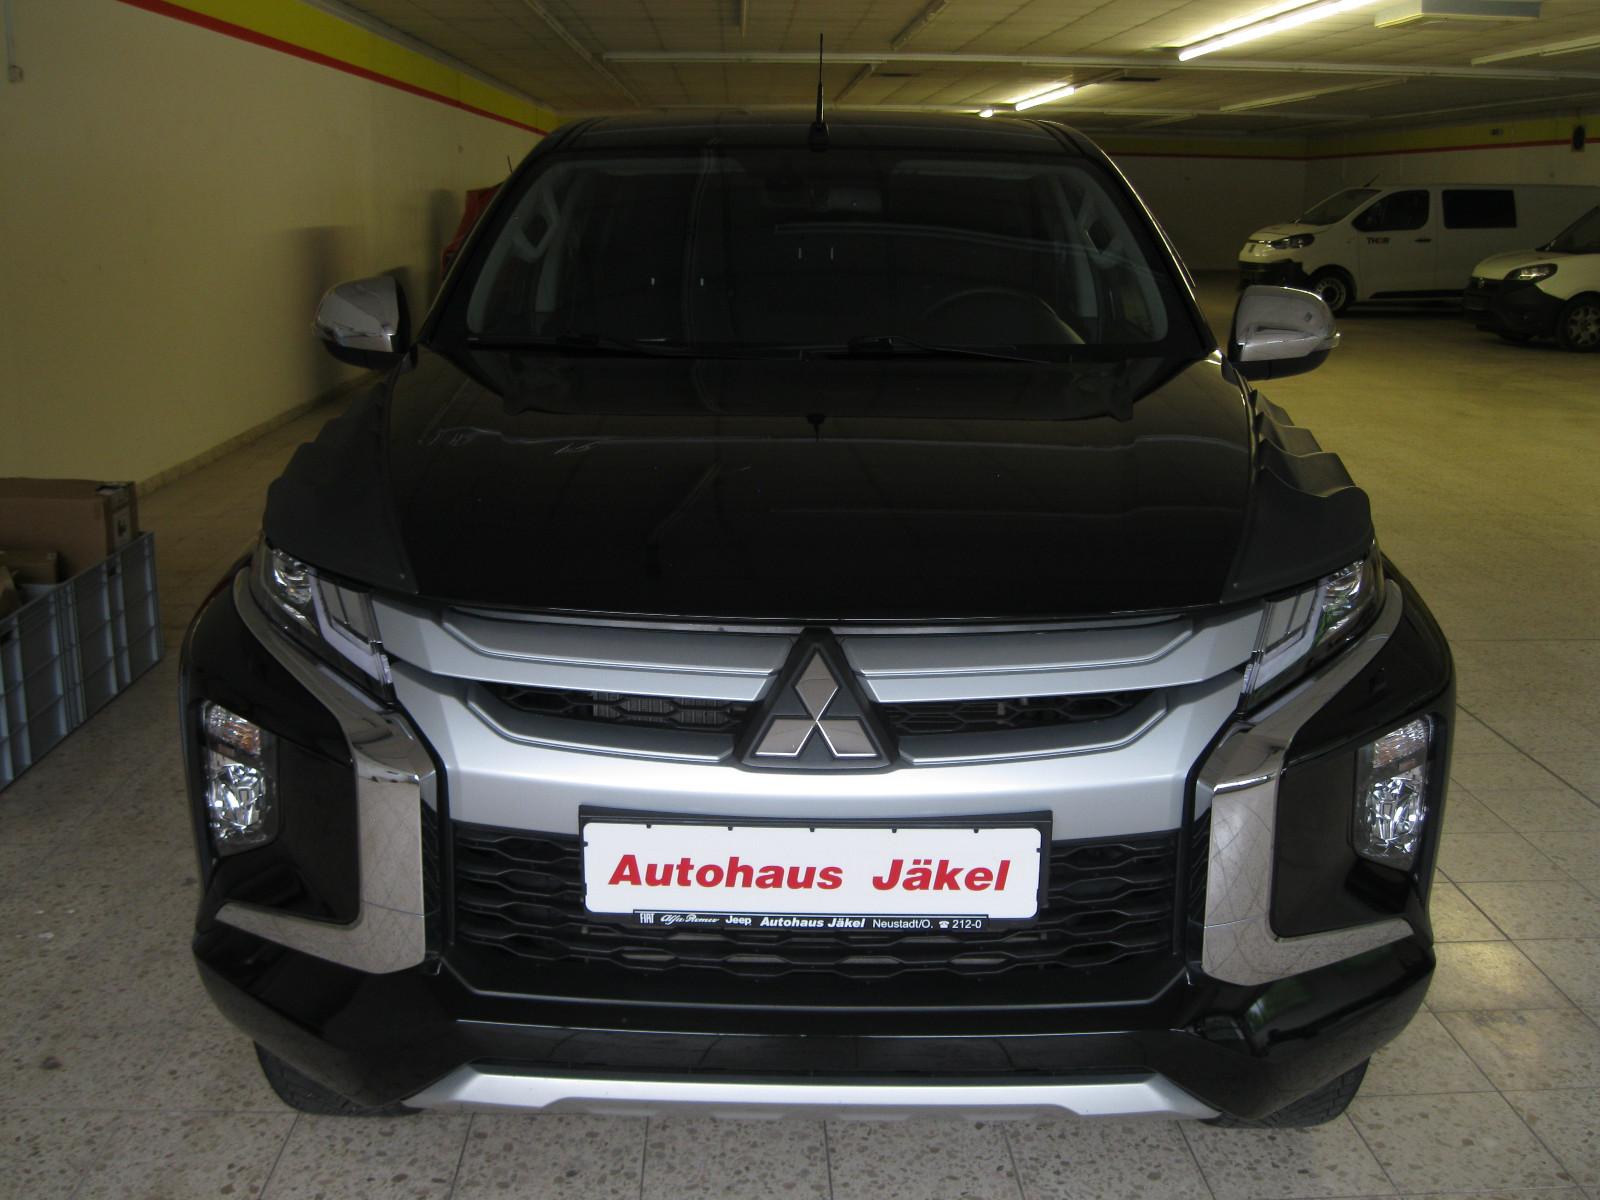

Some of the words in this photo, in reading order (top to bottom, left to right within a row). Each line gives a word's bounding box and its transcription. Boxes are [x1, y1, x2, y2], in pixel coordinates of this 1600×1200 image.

[608, 854, 843, 889] Autohaus
[872, 859, 1010, 891] Jäkel
[640, 912, 655, 924] FIAT
[725, 915, 752, 926] Jeep
[759, 916, 825, 928] Autohaus
[827, 917, 866, 928] Jäkel
[872, 919, 934, 930] Neustadt/O.
[952, 920, 982, 930] 212-0
